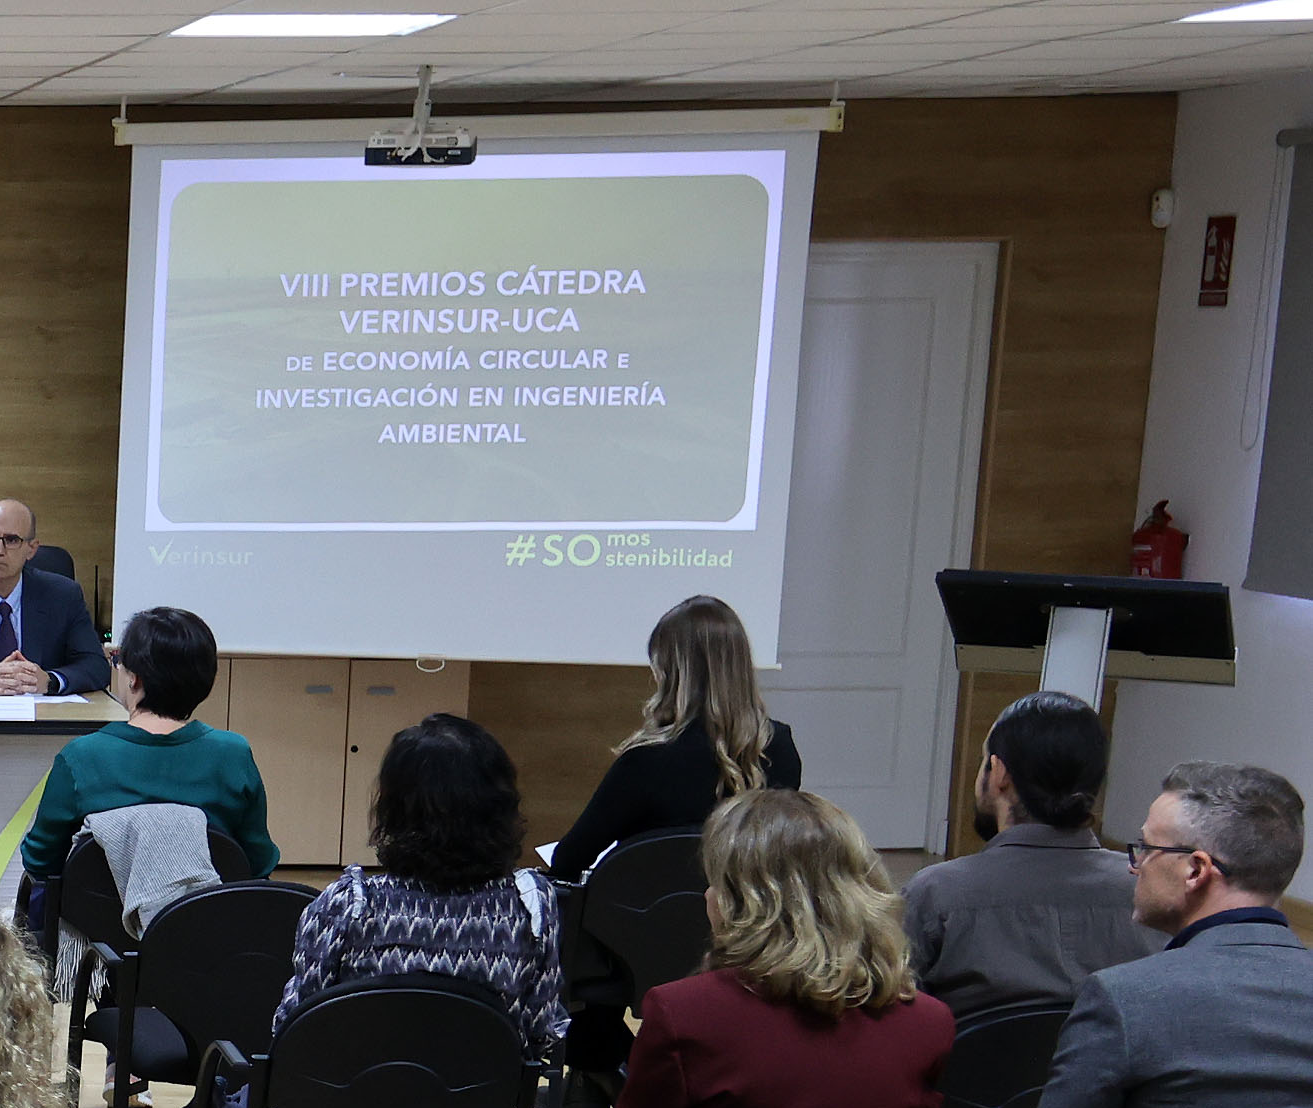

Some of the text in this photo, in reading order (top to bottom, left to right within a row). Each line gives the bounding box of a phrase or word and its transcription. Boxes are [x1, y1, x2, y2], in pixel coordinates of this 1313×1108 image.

[279, 264, 647, 298] VIII PREMIOS CÁTEDRA
[339, 308, 581, 335] VERINSUR-UCA
[285, 346, 630, 372] DE ECONOMÍA CIRCULAR E
[255, 381, 667, 409] INVESTIGACIÓN EN INGENIERÍA
[377, 423, 527, 444] AMBIENTAL
[148, 536, 255, 566] Verinsur
[505, 533, 651, 567] #SO mos
[605, 548, 734, 568] stenibilidad
